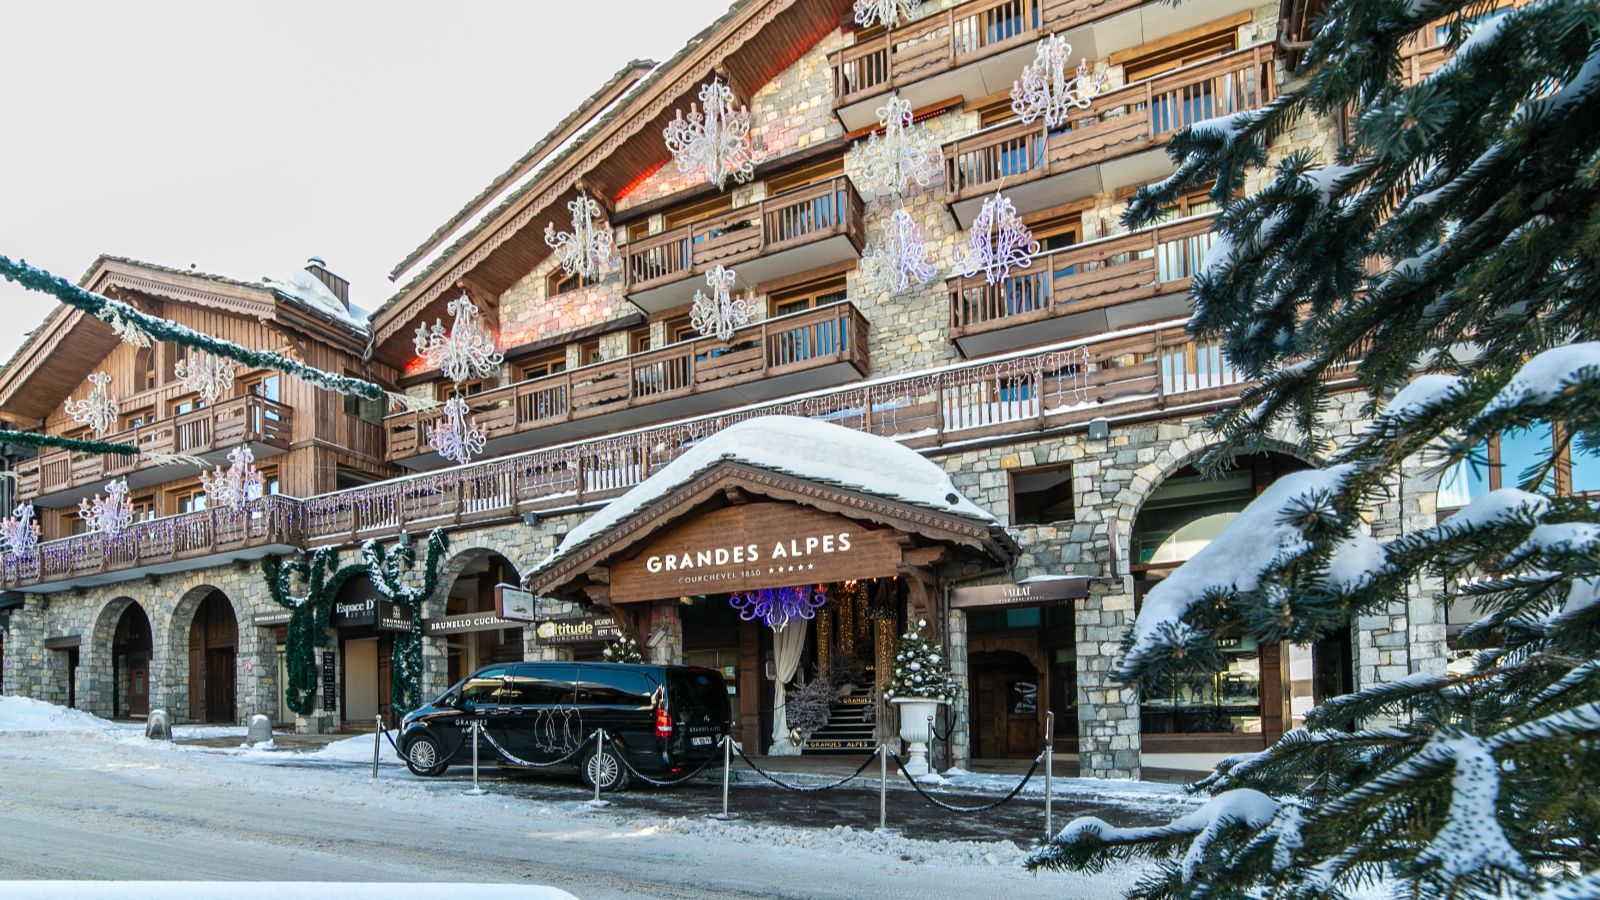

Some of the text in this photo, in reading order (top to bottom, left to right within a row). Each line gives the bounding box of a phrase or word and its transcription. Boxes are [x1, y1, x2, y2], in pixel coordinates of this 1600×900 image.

[646, 532, 852, 573] GRANDES ALPES
[678, 569, 761, 584] COURCHEVEL 1850
[1002, 585, 1031, 597] VALLAT
[336, 602, 365, 618] Espace
[431, 619, 471, 630] BRUNELLO
